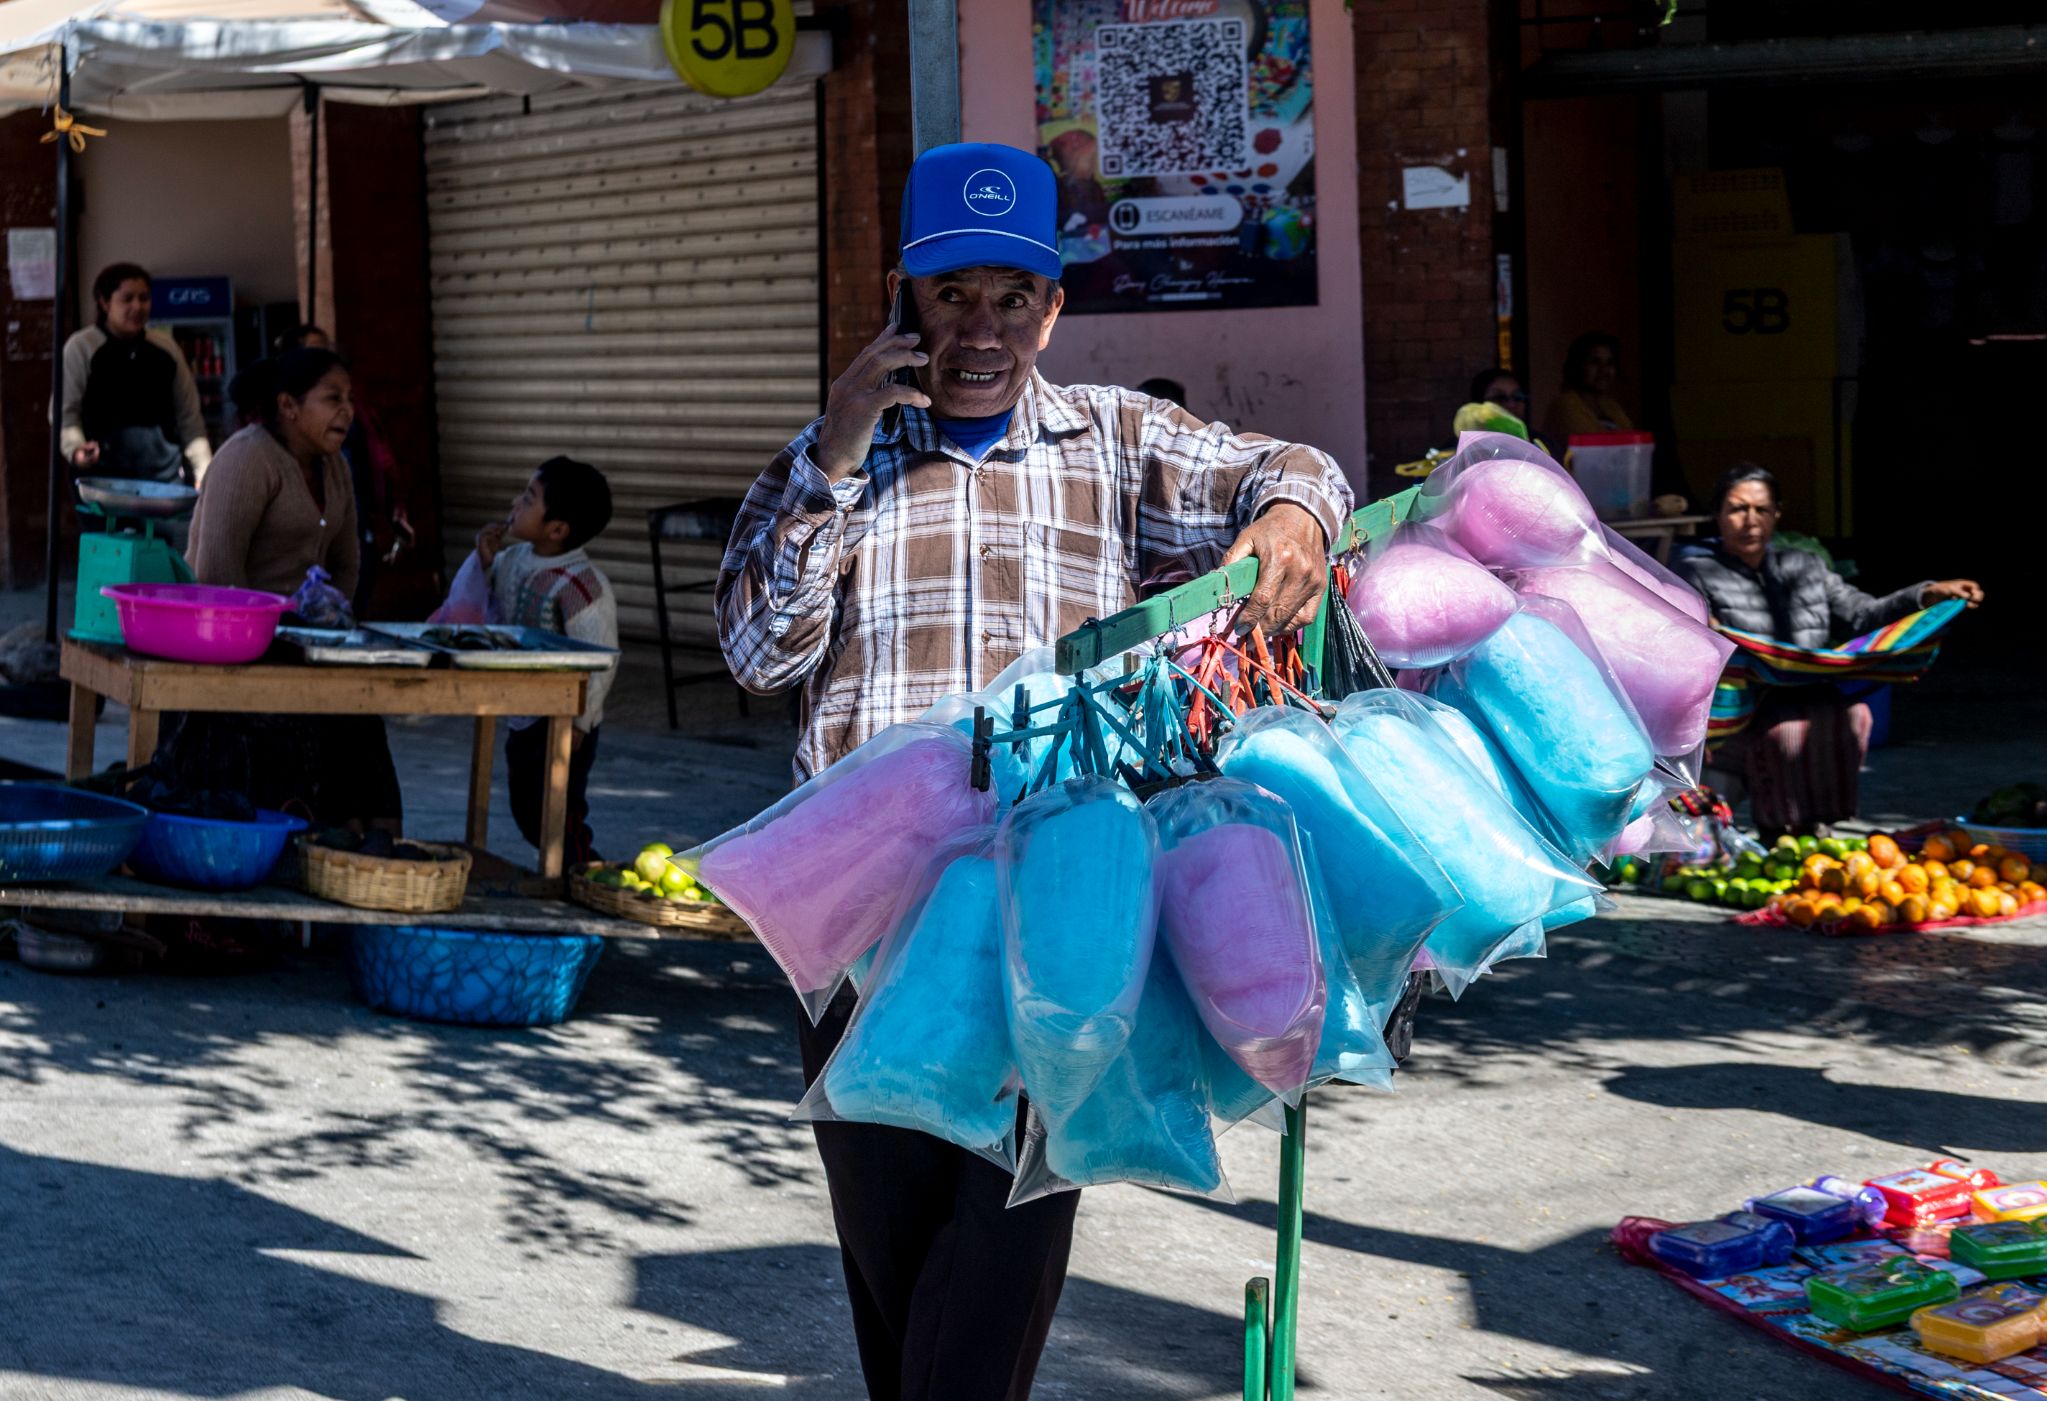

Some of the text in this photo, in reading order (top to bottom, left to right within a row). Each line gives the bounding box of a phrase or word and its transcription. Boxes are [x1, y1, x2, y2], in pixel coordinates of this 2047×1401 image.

[692, 0, 778, 60] 5B
[969, 193, 1010, 201] O'NEILL
[1146, 207, 1225, 223] ESCANÉAME
[1114, 239, 1141, 249] Para
[1722, 288, 1790, 335] 5B
